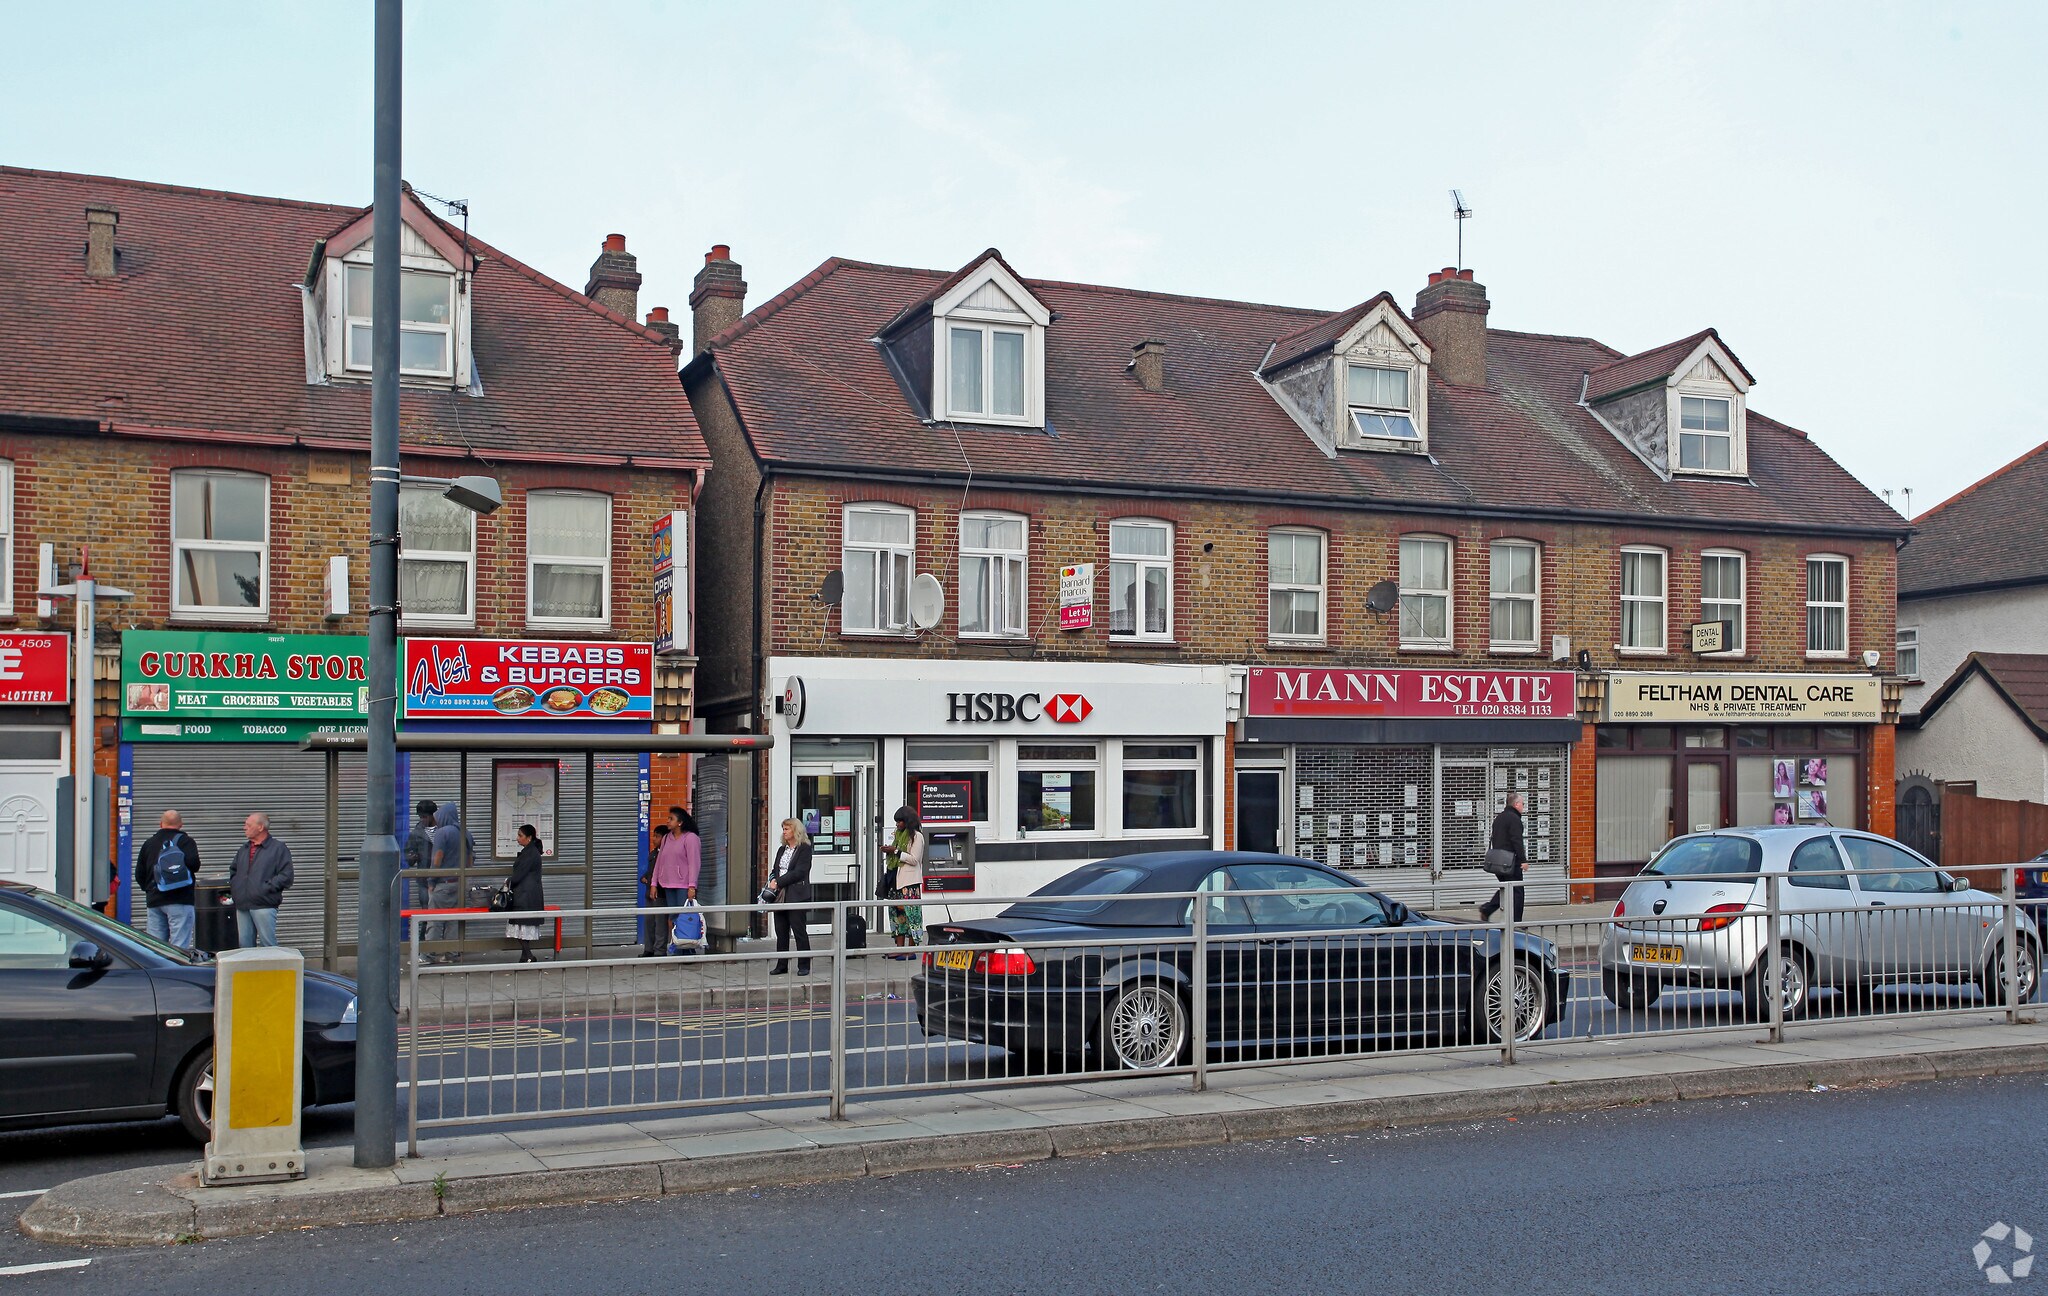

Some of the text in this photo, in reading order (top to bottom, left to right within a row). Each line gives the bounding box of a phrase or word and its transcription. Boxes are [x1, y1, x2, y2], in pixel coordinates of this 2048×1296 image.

[654, 574, 673, 595] OPEN
[1061, 575, 1090, 588] barnard
[1061, 588, 1087, 597] marcus
[1068, 607, 1091, 618] Let by
[1696, 627, 1719, 637] DENTAL
[19, 639, 52, 648] 4505
[1699, 638, 1716, 647] CARE
[498, 646, 625, 665] KEBABS
[140, 651, 369, 681] GURKHA STOR
[411, 644, 471, 705] West
[480, 666, 641, 685] & BURGERS
[1273, 672, 1553, 703] MANN ESTATE
[7, 690, 53, 701] LOTTERY
[1638, 685, 1854, 702] FELTHAM DENTAL CARE
[177, 695, 353, 707] MEAT GROCERIES VEGETABLES
[784, 703, 798, 716] SBC
[946, 692, 1041, 722] HSBC
[1453, 705, 1552, 716] TEL 020 8384 1133
[1690, 703, 1807, 711] NHS & PRIVATE TREATMENT
[184, 725, 212, 734] FOOD
[242, 725, 287, 734] TOBACCO
[318, 725, 368, 733] OFF LICEN
[922, 784, 938, 792] Free
